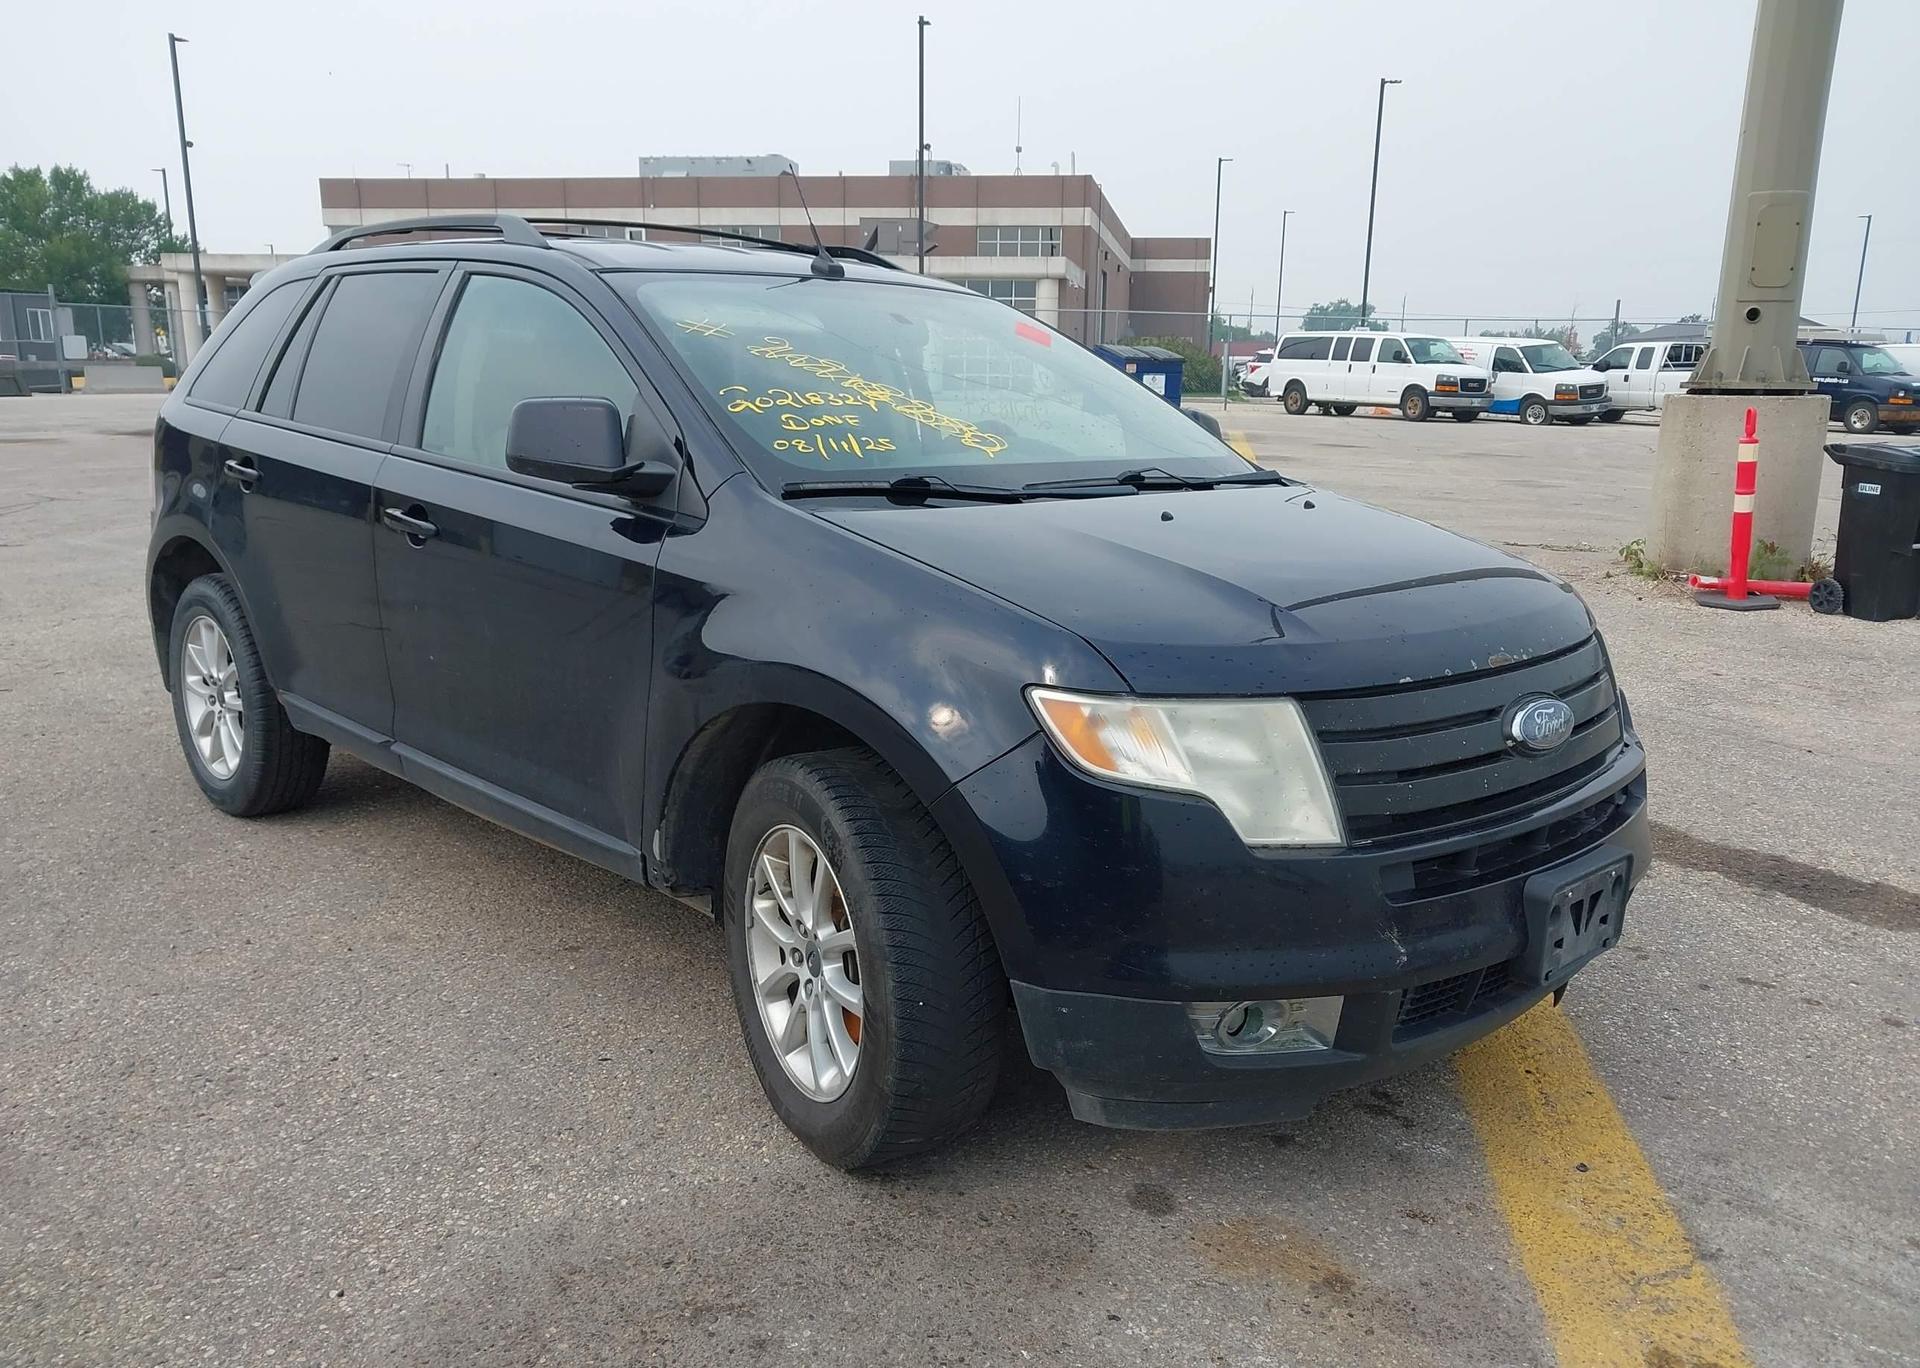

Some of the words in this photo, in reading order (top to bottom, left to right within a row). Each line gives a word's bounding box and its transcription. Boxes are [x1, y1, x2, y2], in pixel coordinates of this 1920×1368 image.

[780, 413, 861, 431] DONE
[772, 432, 897, 460] 08/11/25
[1859, 484, 1880, 494] ULINE
[1535, 707, 1566, 736] Ford
